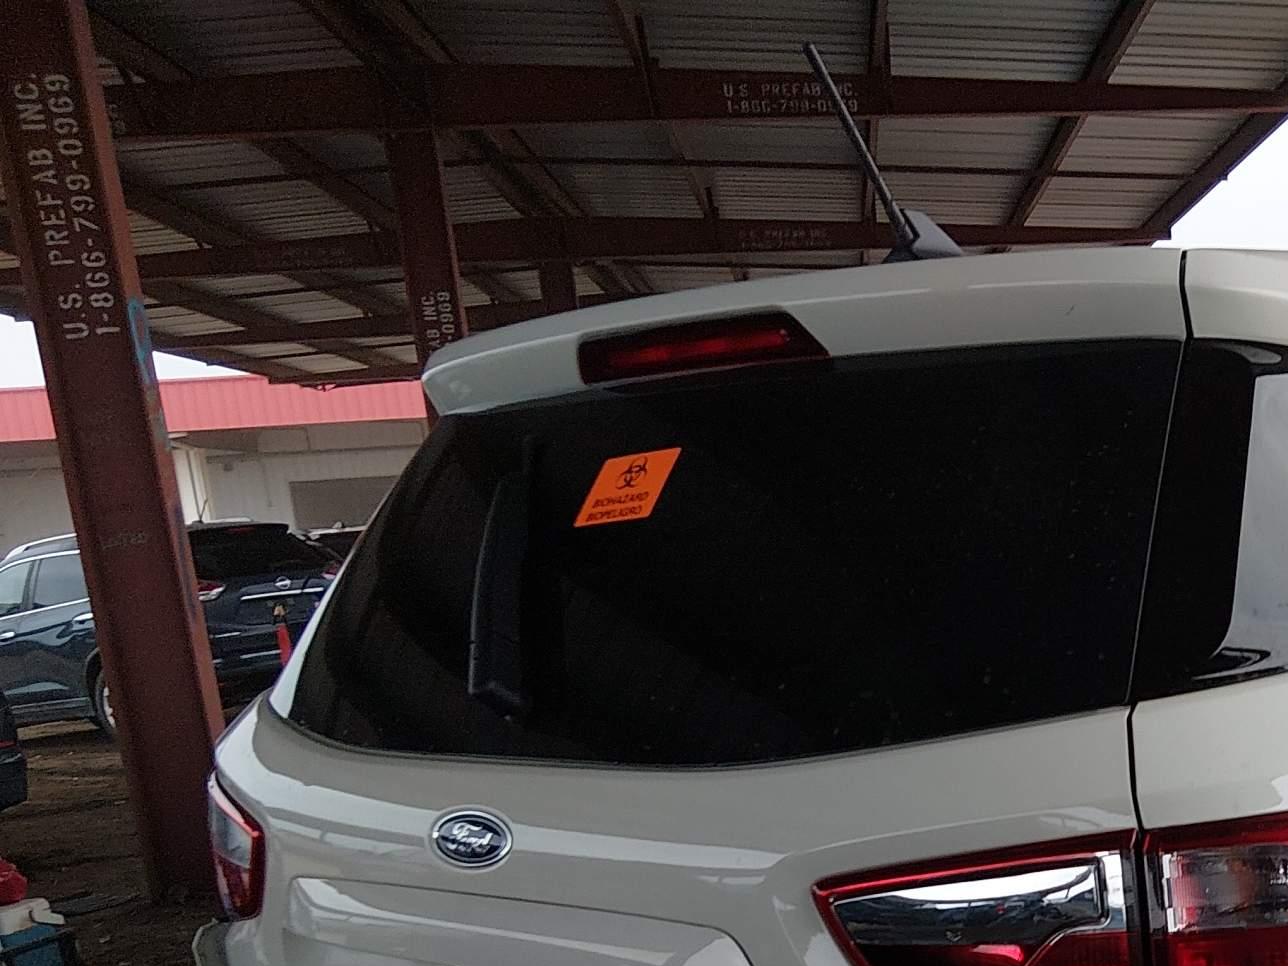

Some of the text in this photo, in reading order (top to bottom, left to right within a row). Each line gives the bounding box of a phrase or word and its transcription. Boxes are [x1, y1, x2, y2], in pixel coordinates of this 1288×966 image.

[14, 73, 90, 339] U.S. PREFAB INC.
[44, 73, 121, 334] 1-866-799-0969
